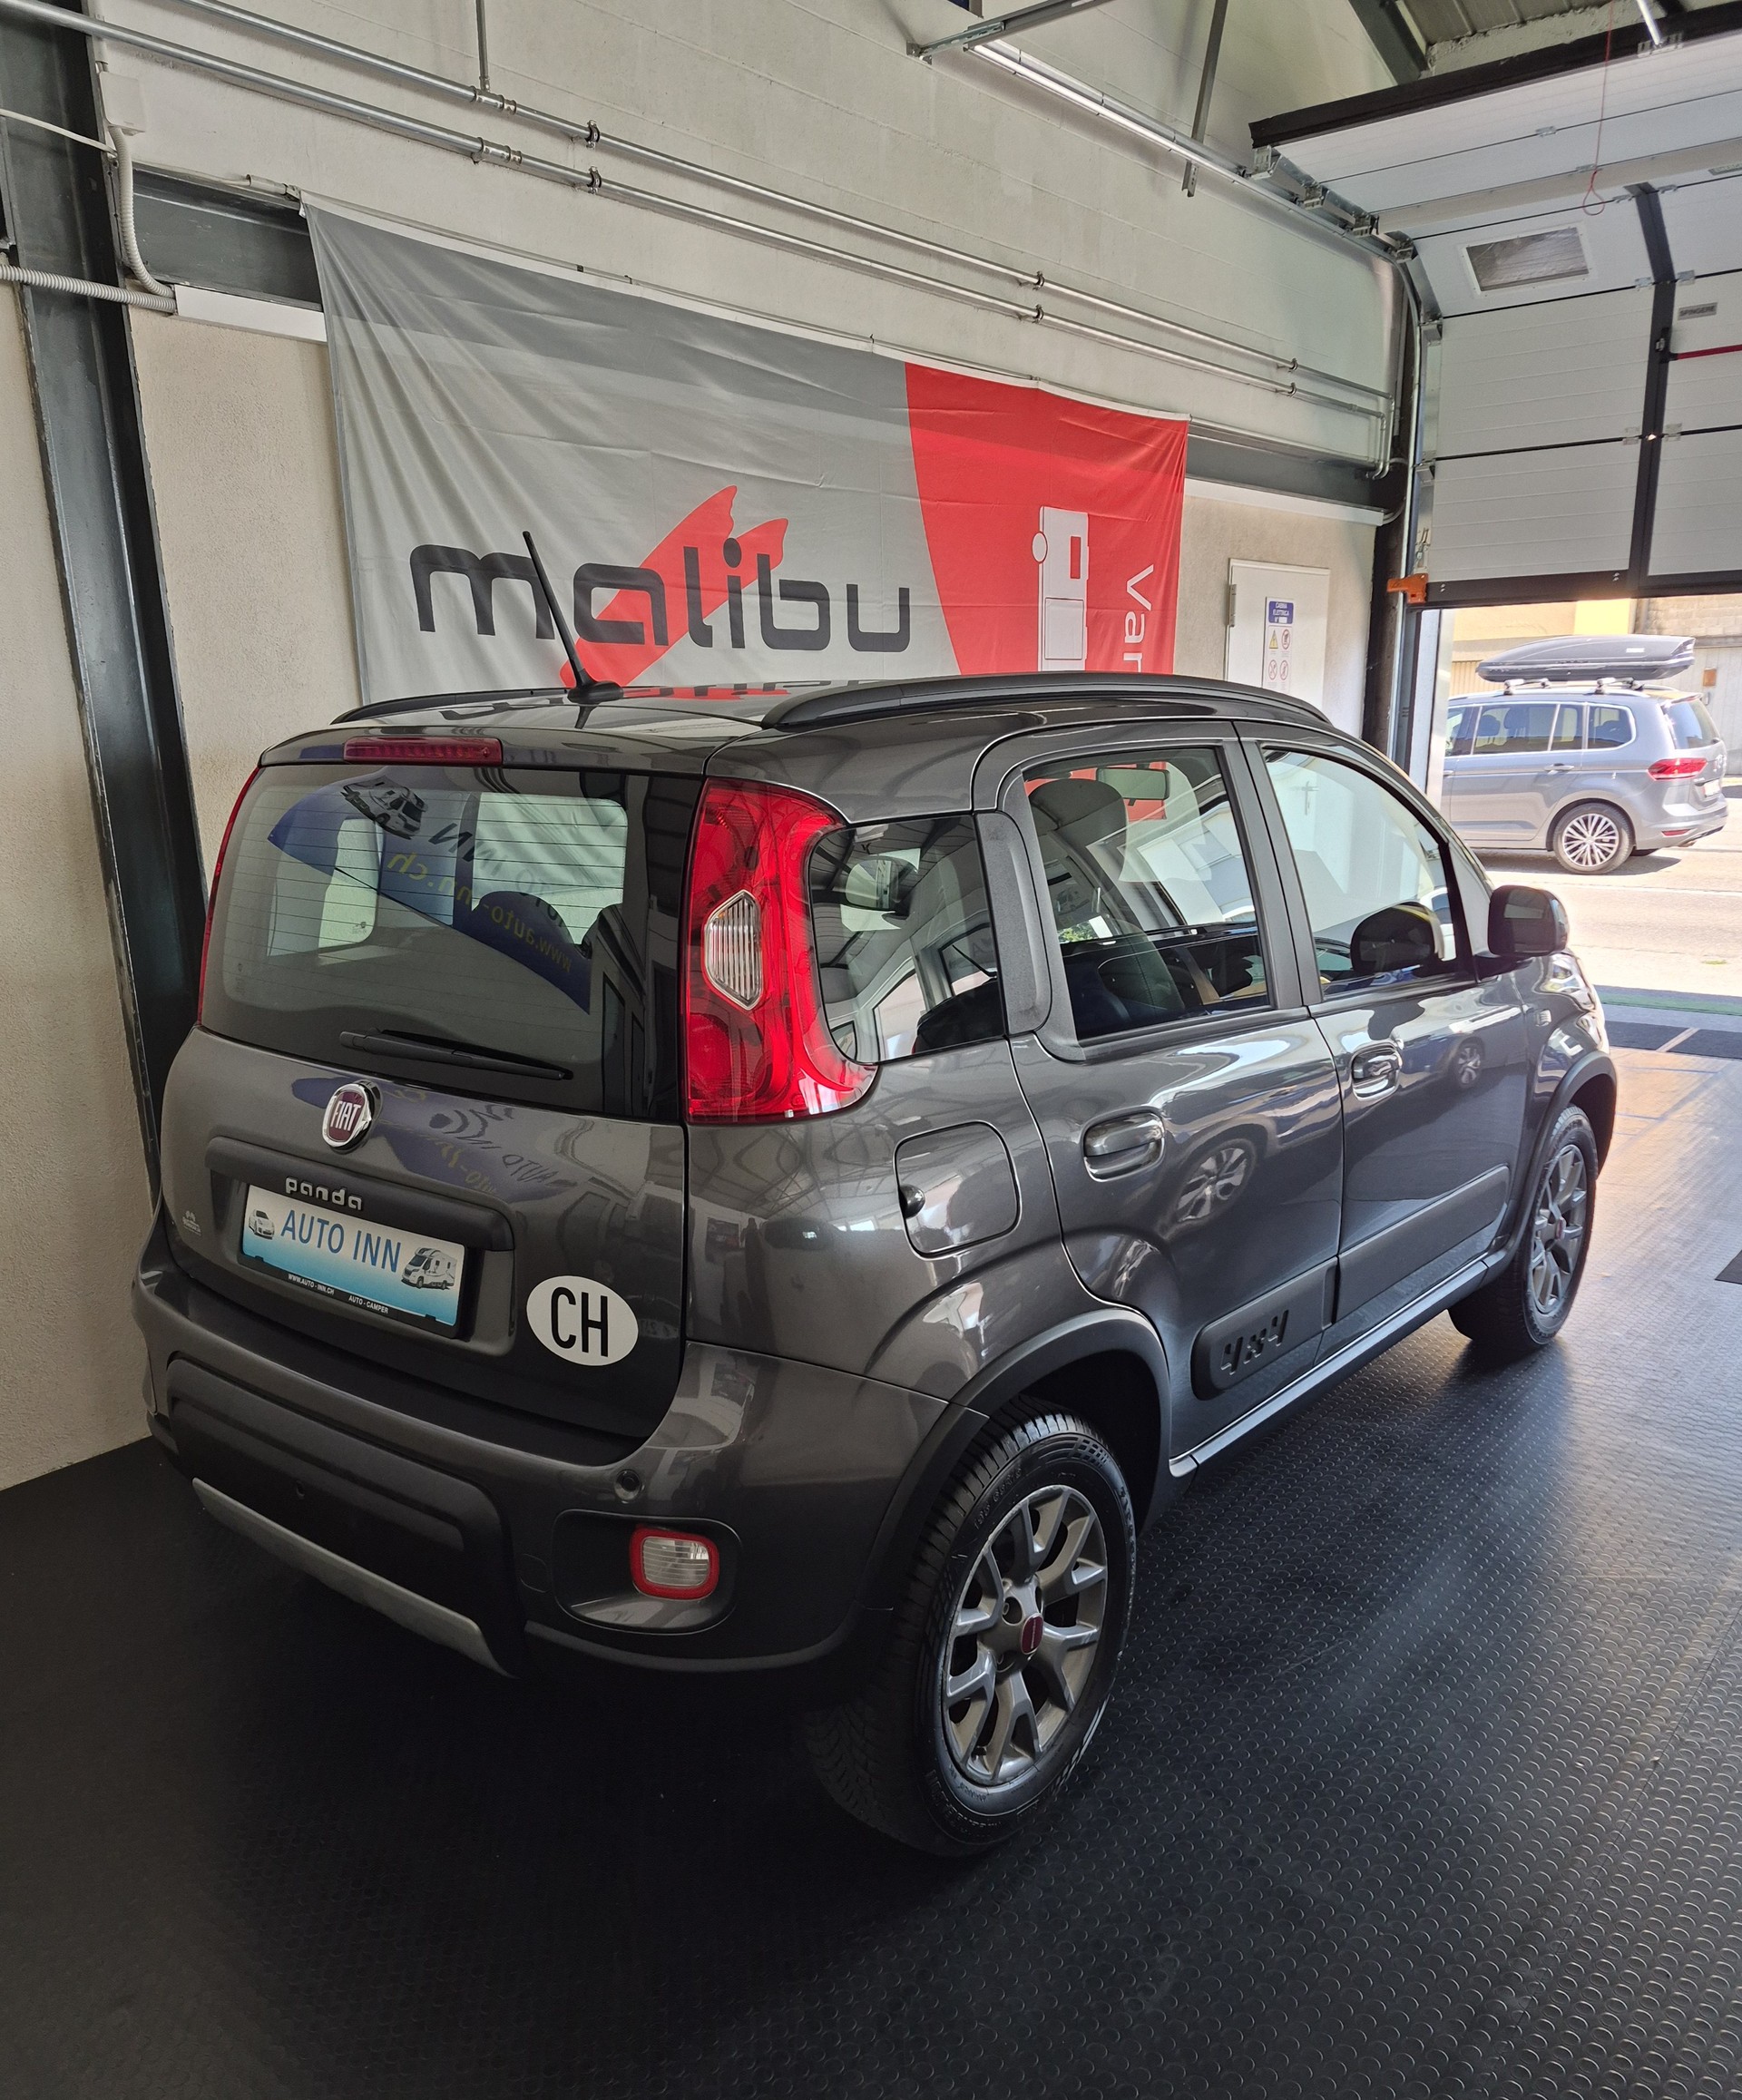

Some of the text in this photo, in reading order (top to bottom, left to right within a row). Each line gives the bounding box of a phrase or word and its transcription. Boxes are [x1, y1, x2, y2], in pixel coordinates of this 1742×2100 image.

[409, 538, 912, 653] malibu
[330, 1100, 362, 1131] FIAT
[285, 1177, 362, 1211] panda
[280, 1209, 402, 1273] AUTO INN
[348, 1294, 363, 1305] AUTO
[367, 1301, 389, 1314] CAMPER
[550, 1286, 610, 1358] CH
[1220, 1309, 1289, 1375] 4x4
